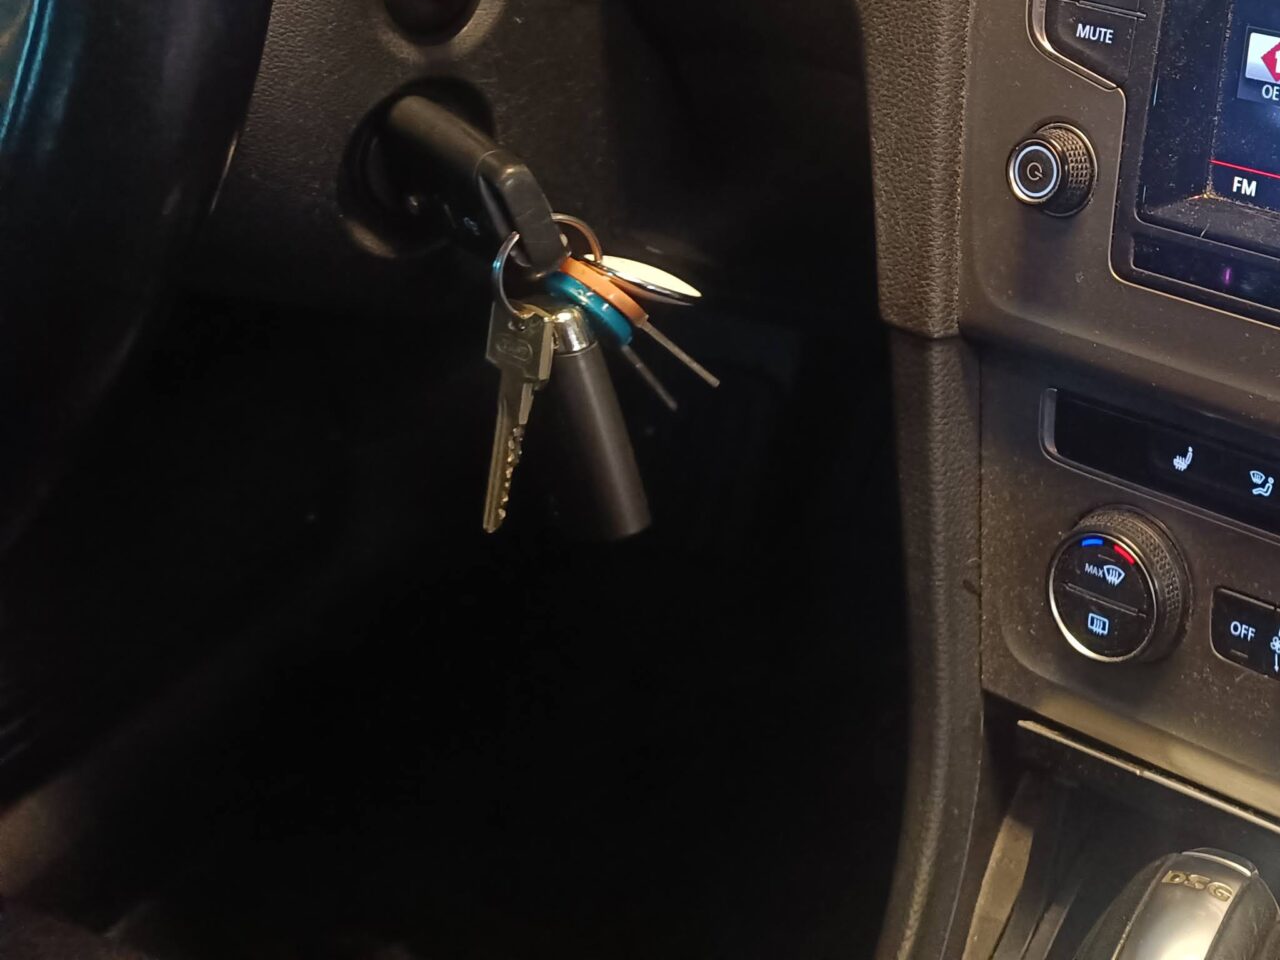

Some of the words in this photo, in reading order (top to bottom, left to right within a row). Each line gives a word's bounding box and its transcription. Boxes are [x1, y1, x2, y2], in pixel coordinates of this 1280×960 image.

[1075, 23, 1114, 44] MUTE
[1262, 85, 1280, 102] OE
[1232, 176, 1257, 197] FM
[1084, 563, 1104, 578] MAX
[1230, 621, 1256, 642] OFF
[1161, 870, 1234, 902] DSG
